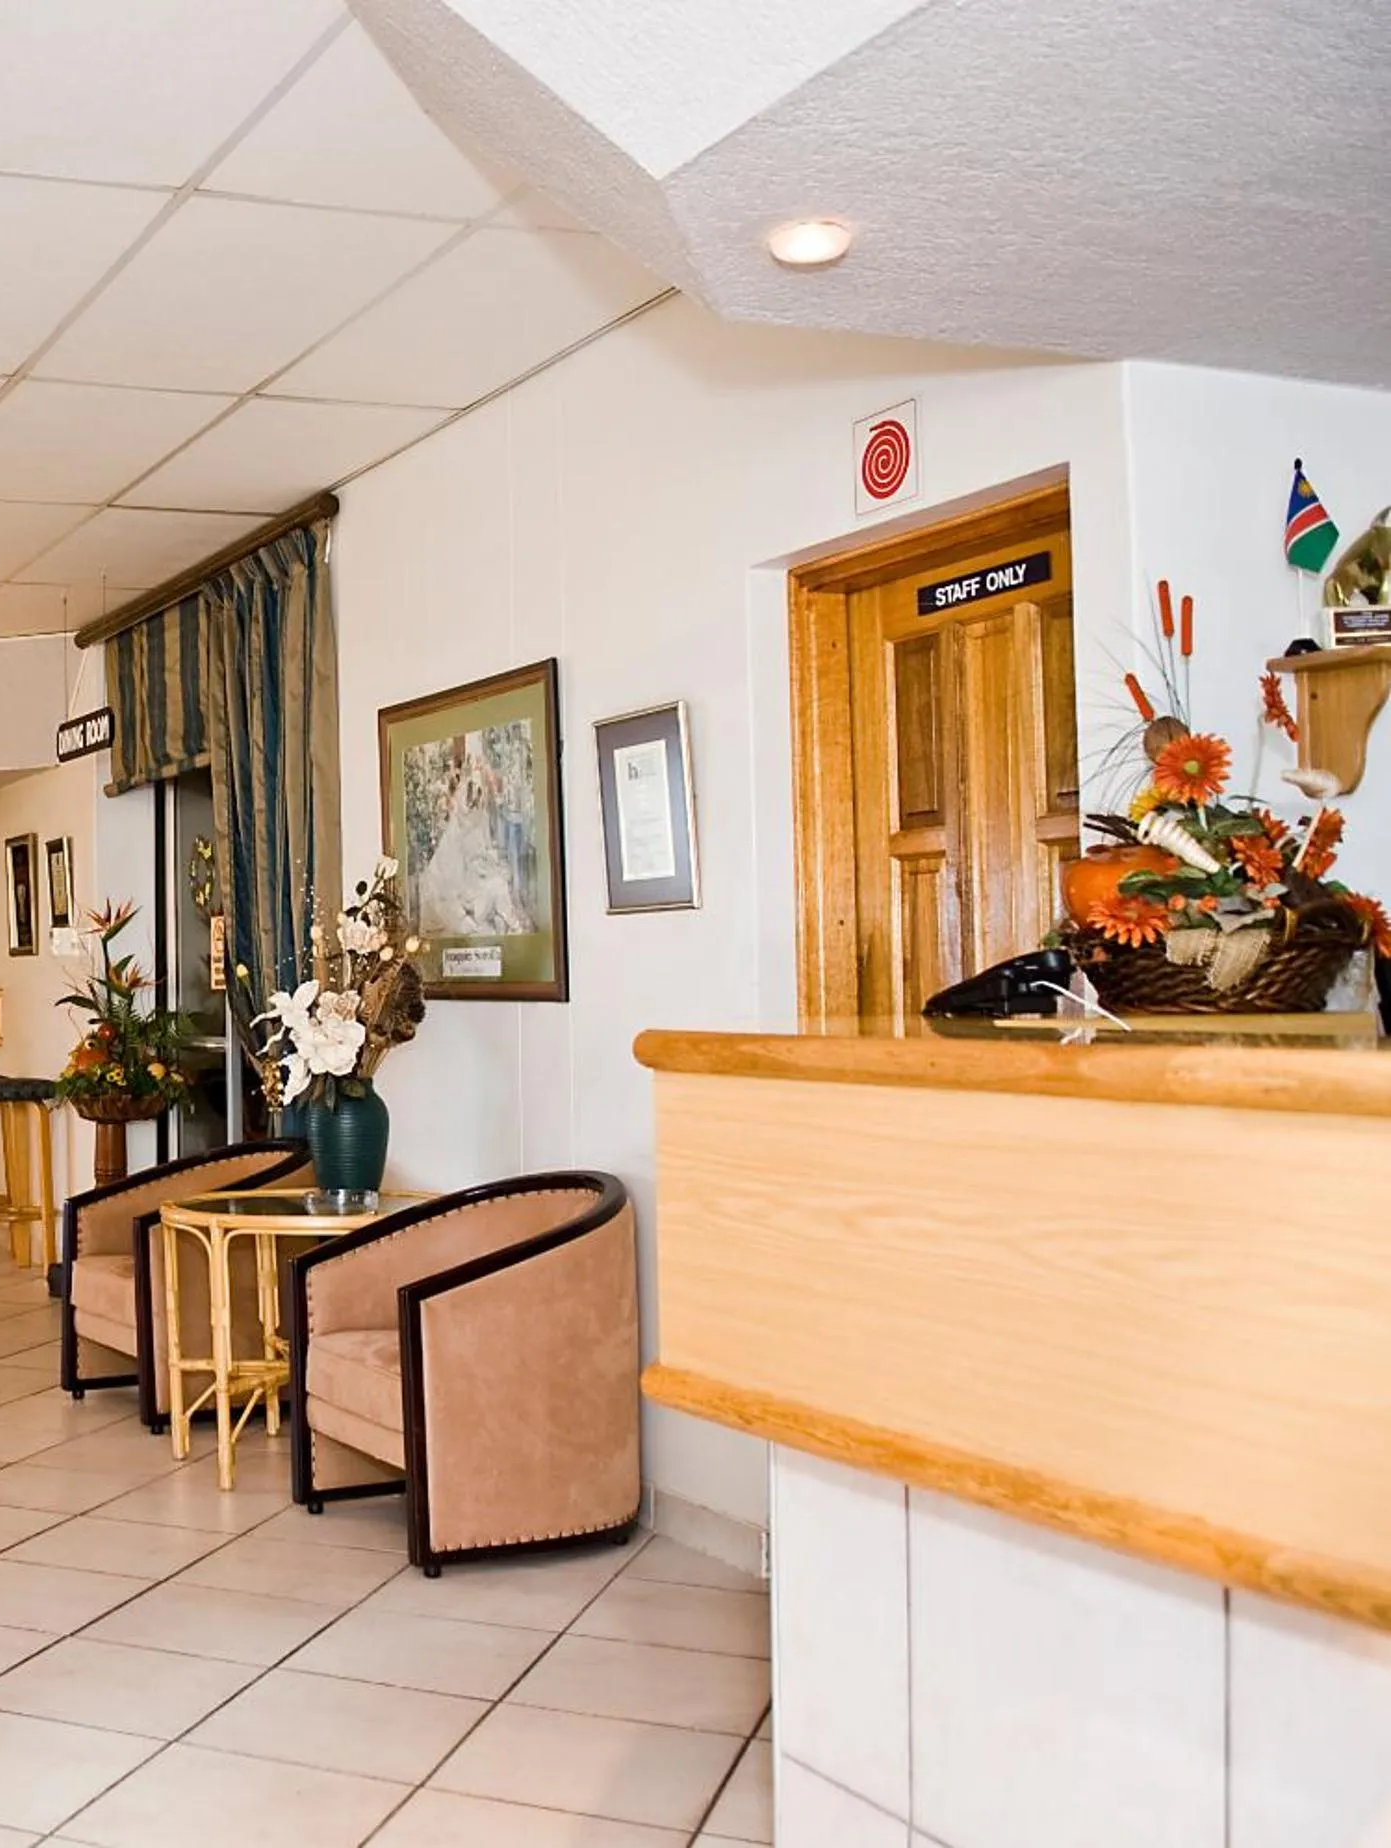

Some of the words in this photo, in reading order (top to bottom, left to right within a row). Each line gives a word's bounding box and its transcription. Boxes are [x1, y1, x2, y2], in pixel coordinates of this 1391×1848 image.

[935, 576, 981, 606] STAFF
[986, 563, 1026, 591] ONLY
[86, 714, 109, 746] ROOM
